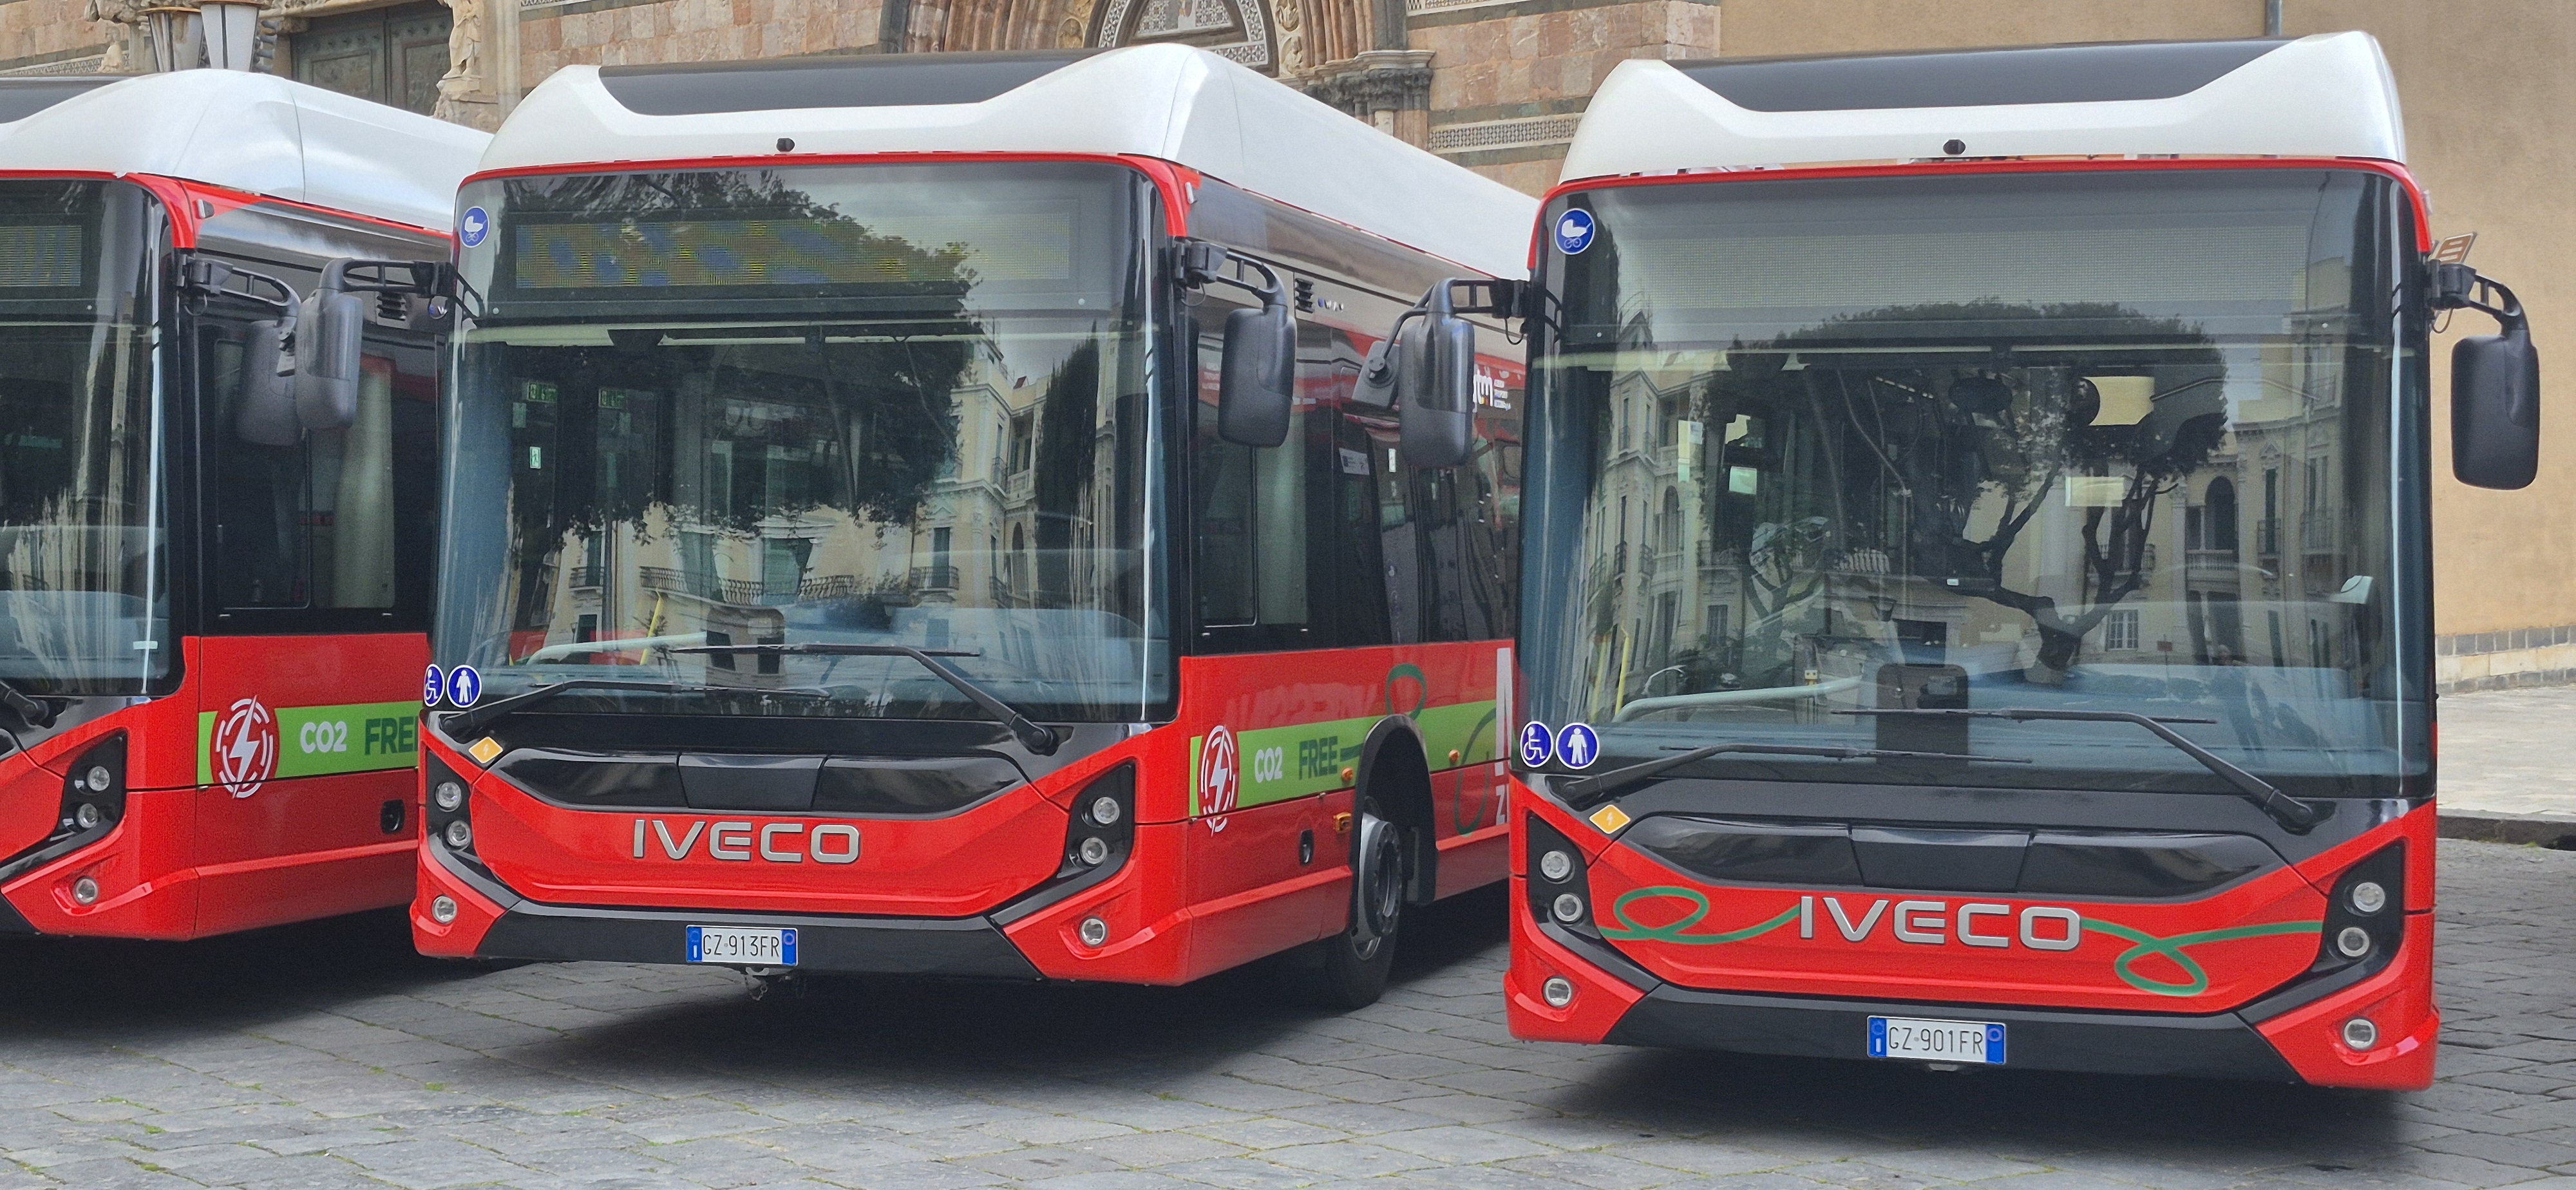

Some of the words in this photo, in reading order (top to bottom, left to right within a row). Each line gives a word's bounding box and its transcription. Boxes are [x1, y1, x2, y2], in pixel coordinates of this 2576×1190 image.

[300, 721, 348, 753] CO2
[1255, 746, 1283, 783] CO2
[1298, 735, 1338, 780] FREE
[633, 819, 860, 864] IVECO
[1800, 896, 2081, 950] IVECO
